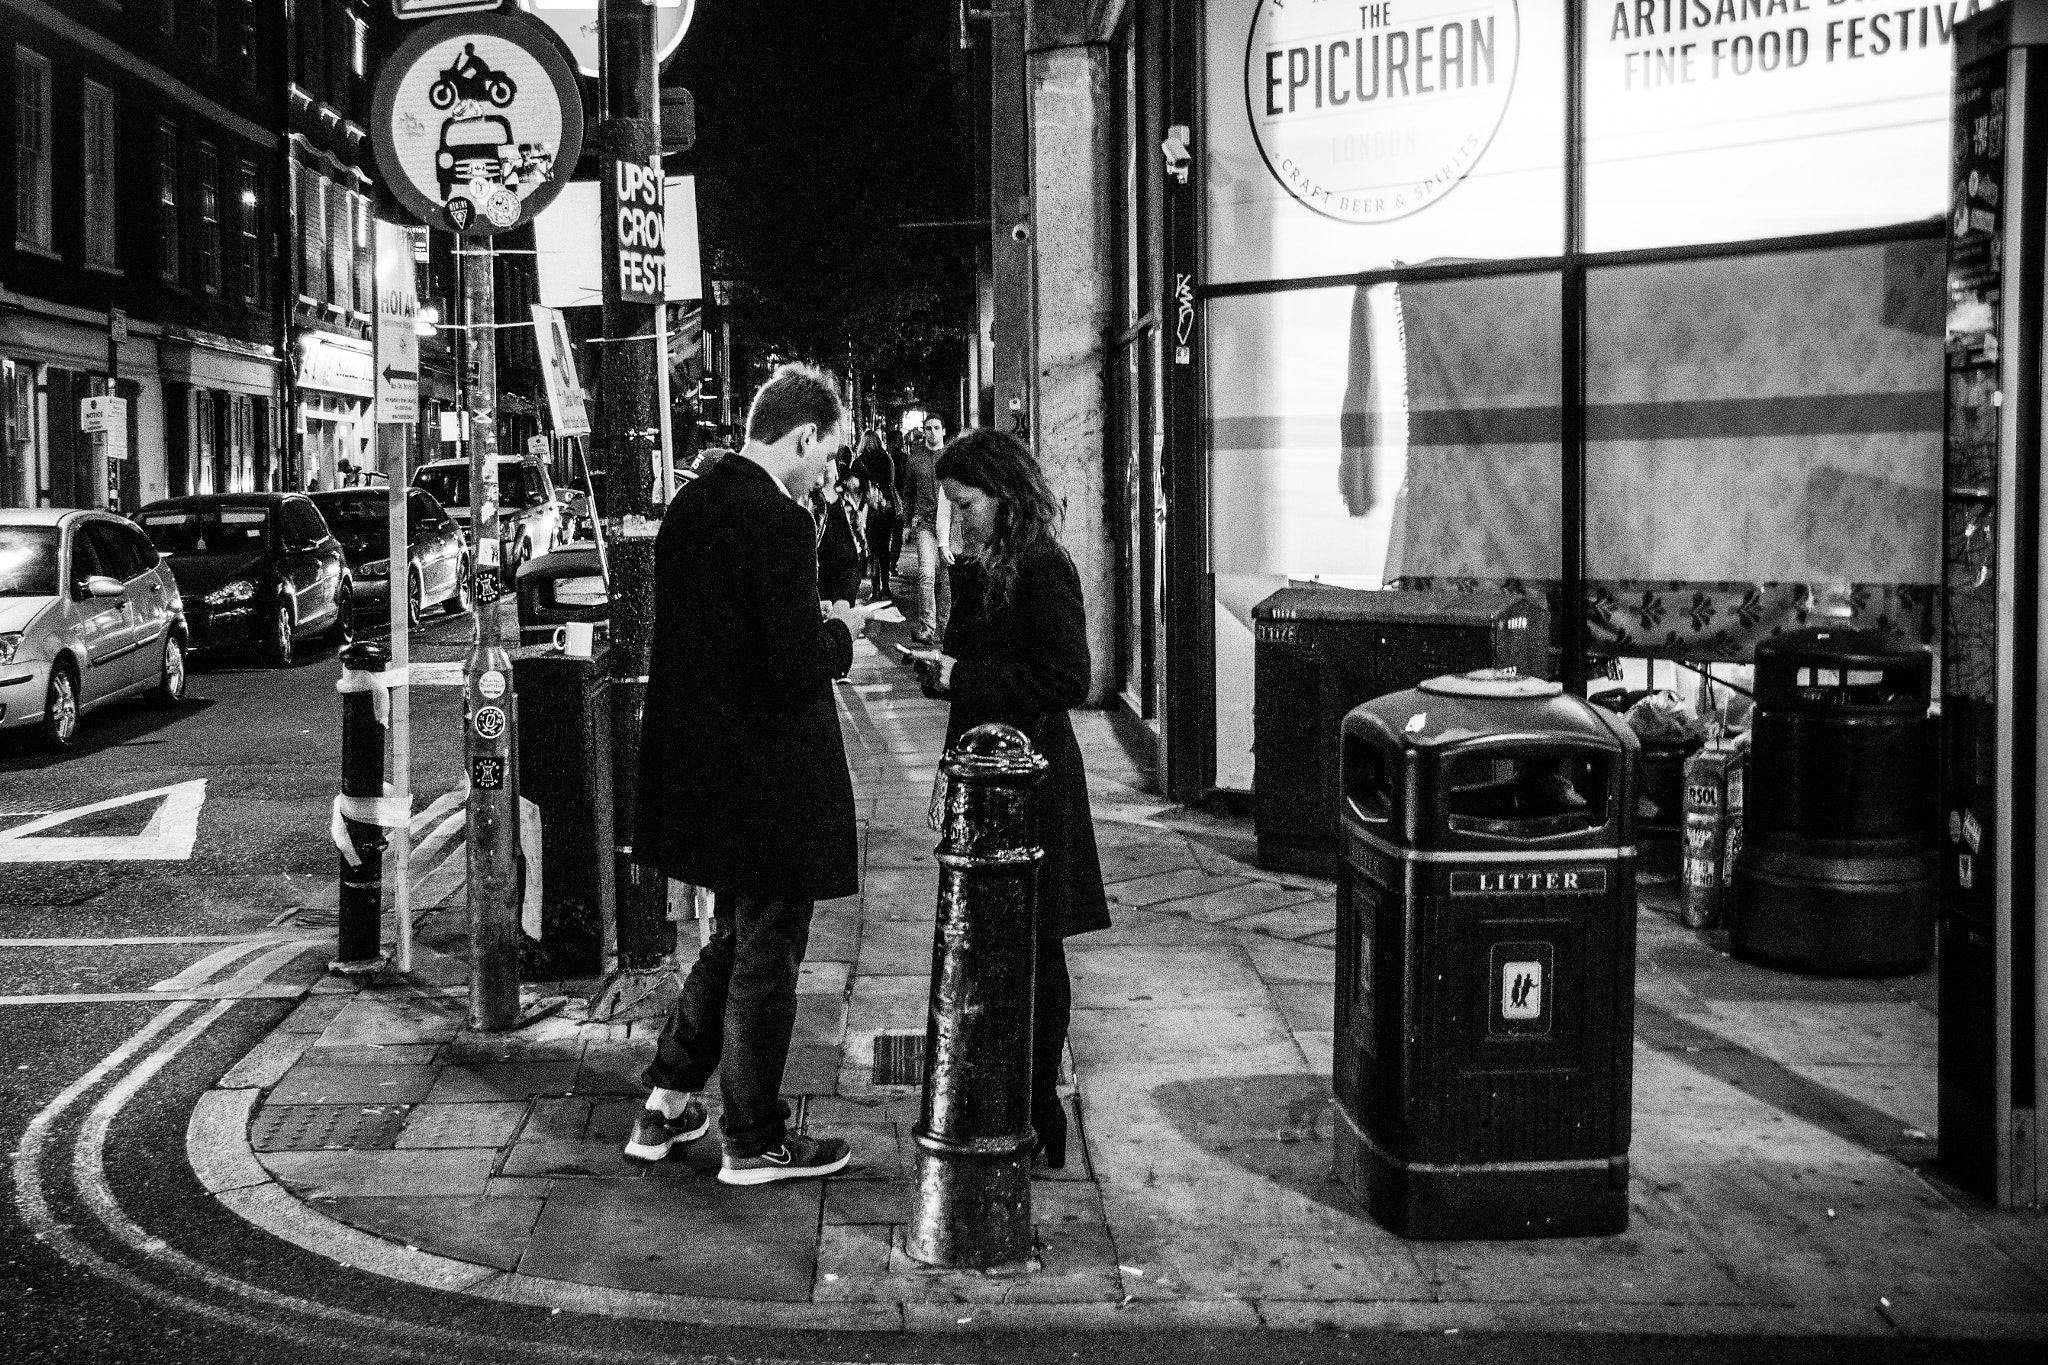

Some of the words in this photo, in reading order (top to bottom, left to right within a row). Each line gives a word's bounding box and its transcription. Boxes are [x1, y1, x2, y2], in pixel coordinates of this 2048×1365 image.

[1360, 2, 1391, 30] THE
[1265, 16, 1495, 117] EPICUREAN
[1624, 43, 1697, 91] FINE
[1711, 27, 1809, 79] FOOD
[1826, 0, 1998, 63] FESTIV
[1331, 128, 1417, 165] LONDON
[617, 160, 665, 206] UPST
[1281, 158, 1334, 205] CRAFT
[1340, 197, 1385, 213] BEER
[1395, 194, 1405, 207] &
[1414, 134, 1479, 201] SPIRITS
[620, 250, 665, 295] FEST
[1479, 873, 1579, 891] LITTER
